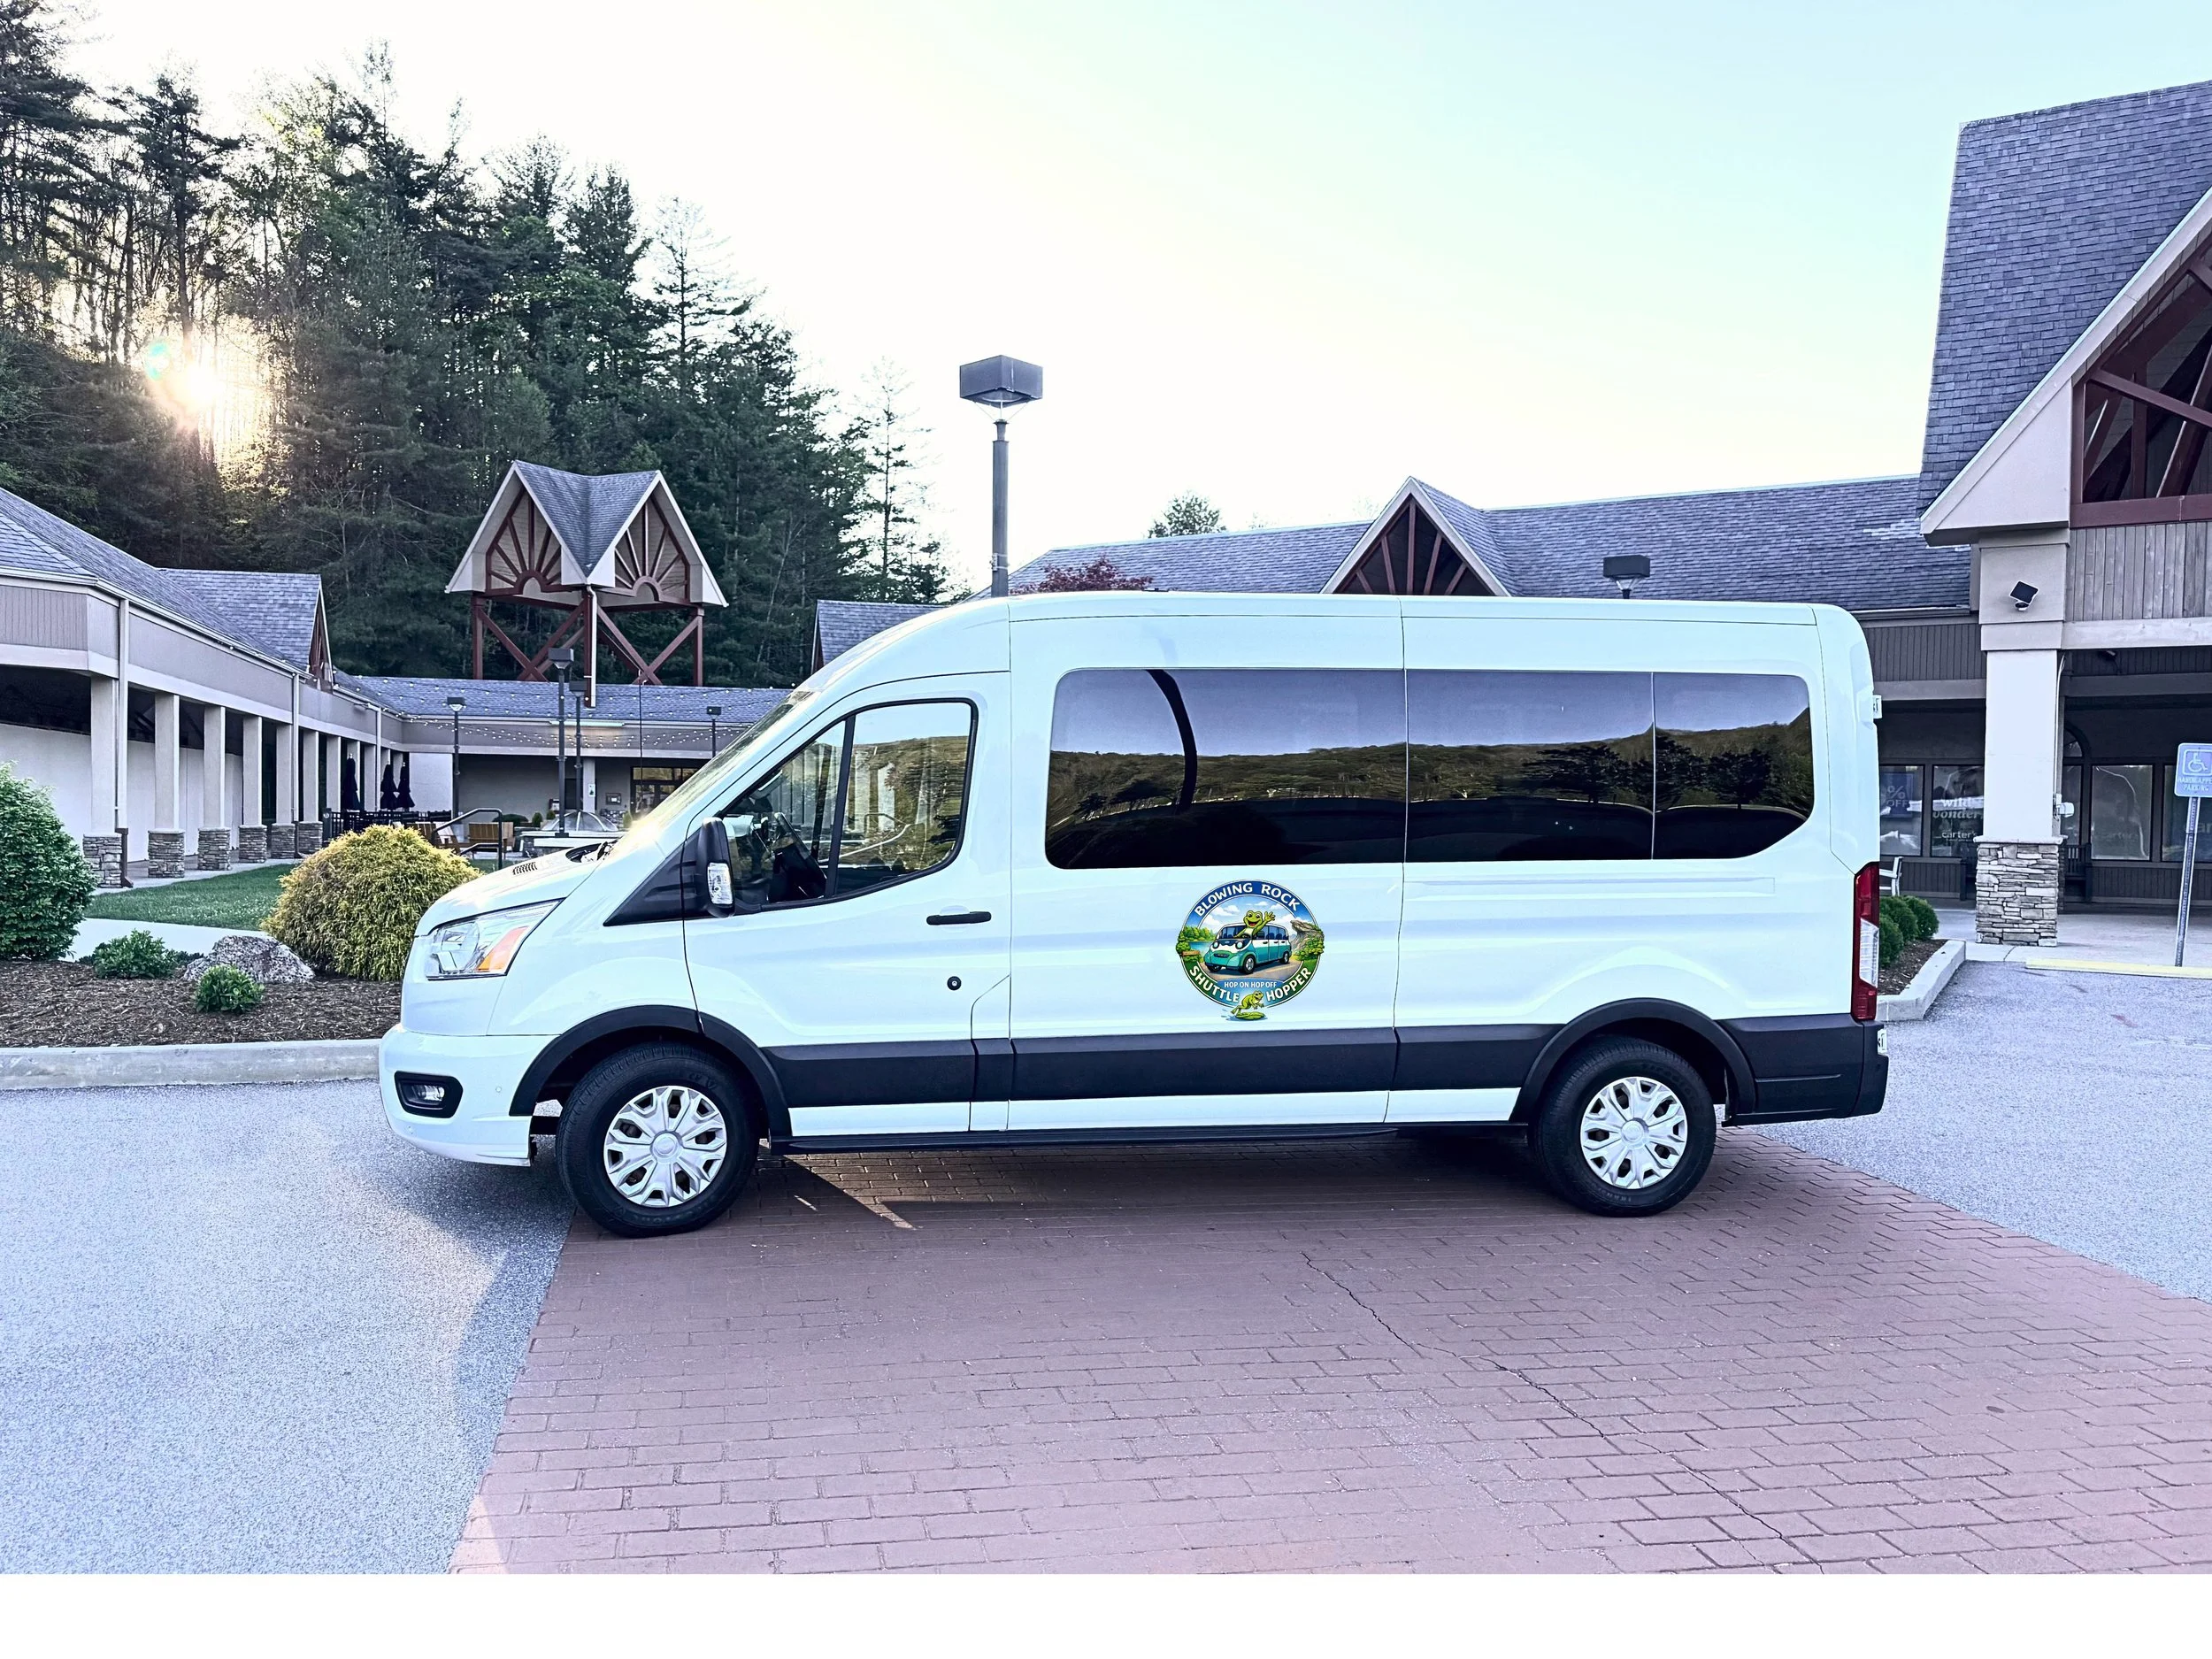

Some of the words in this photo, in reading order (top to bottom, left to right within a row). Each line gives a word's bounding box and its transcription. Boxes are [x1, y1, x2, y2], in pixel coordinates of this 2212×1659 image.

[1886, 799, 1909, 808] OFF
[1194, 882, 1253, 917] BLOWING
[1261, 883, 1301, 911] ROCK
[1189, 965, 1240, 1002] SHUTTLE
[1265, 967, 1311, 1002] HOPPER
